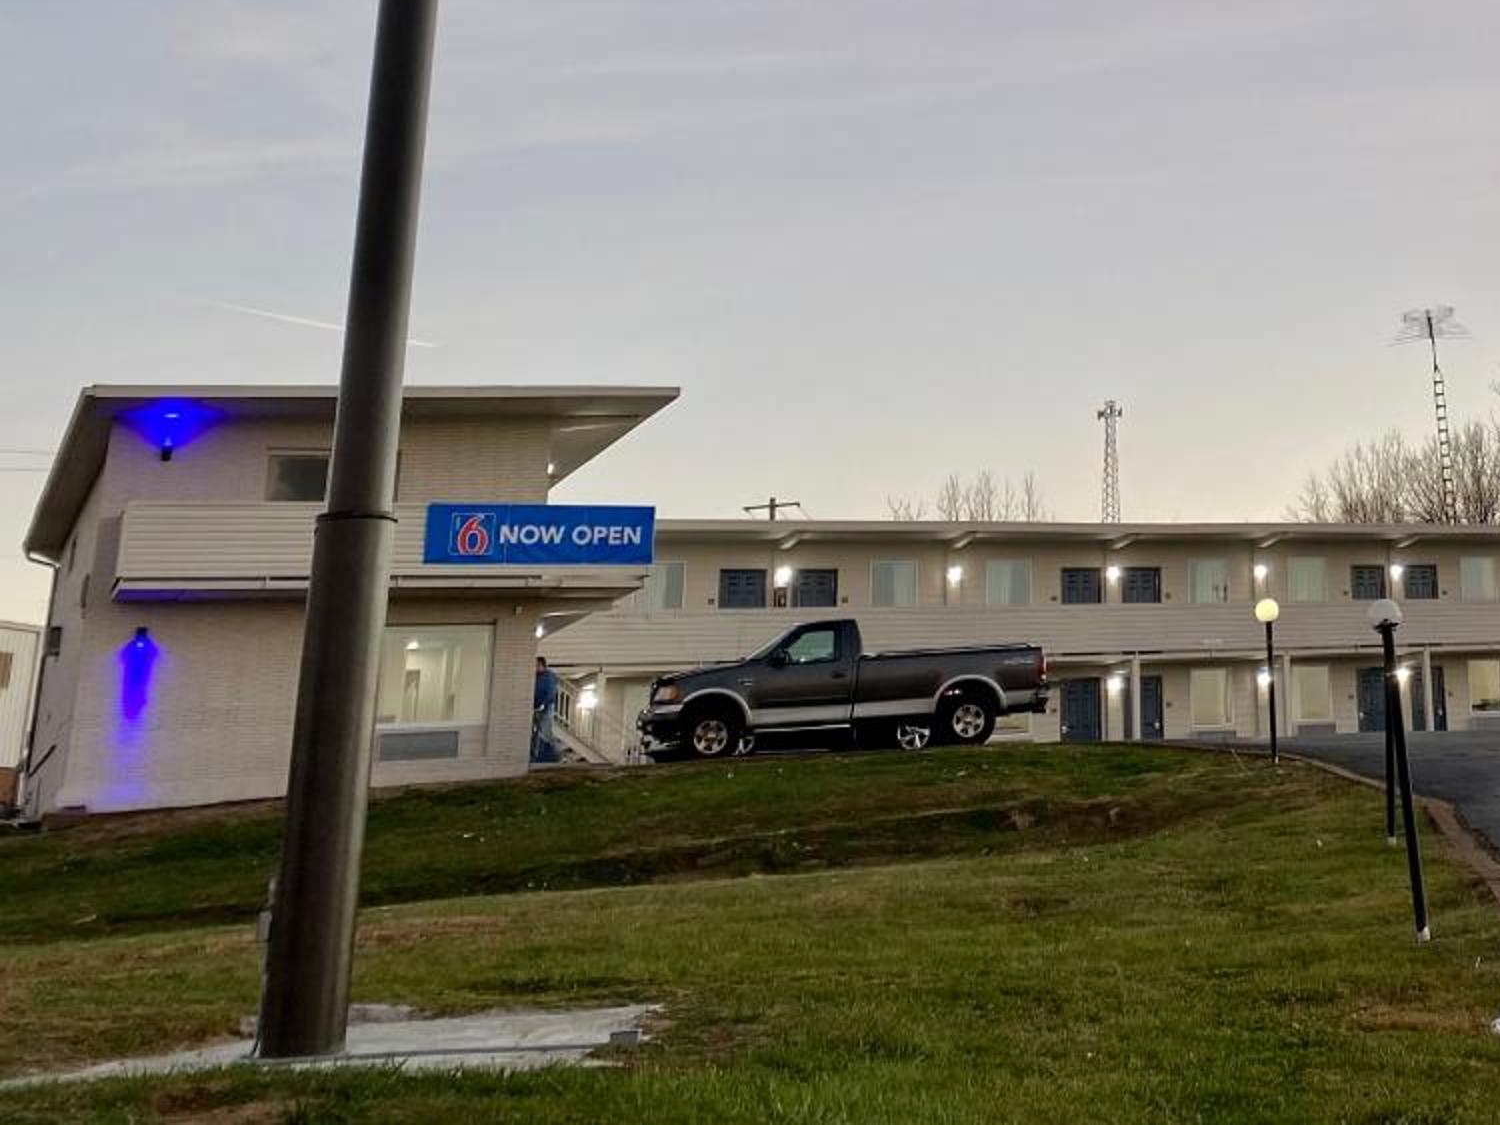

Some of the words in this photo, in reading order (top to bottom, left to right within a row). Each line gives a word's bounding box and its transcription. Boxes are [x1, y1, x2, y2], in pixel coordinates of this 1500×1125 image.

[457, 514, 489, 556] 6
[499, 524, 565, 545] NOW
[571, 526, 641, 546] OPEN
